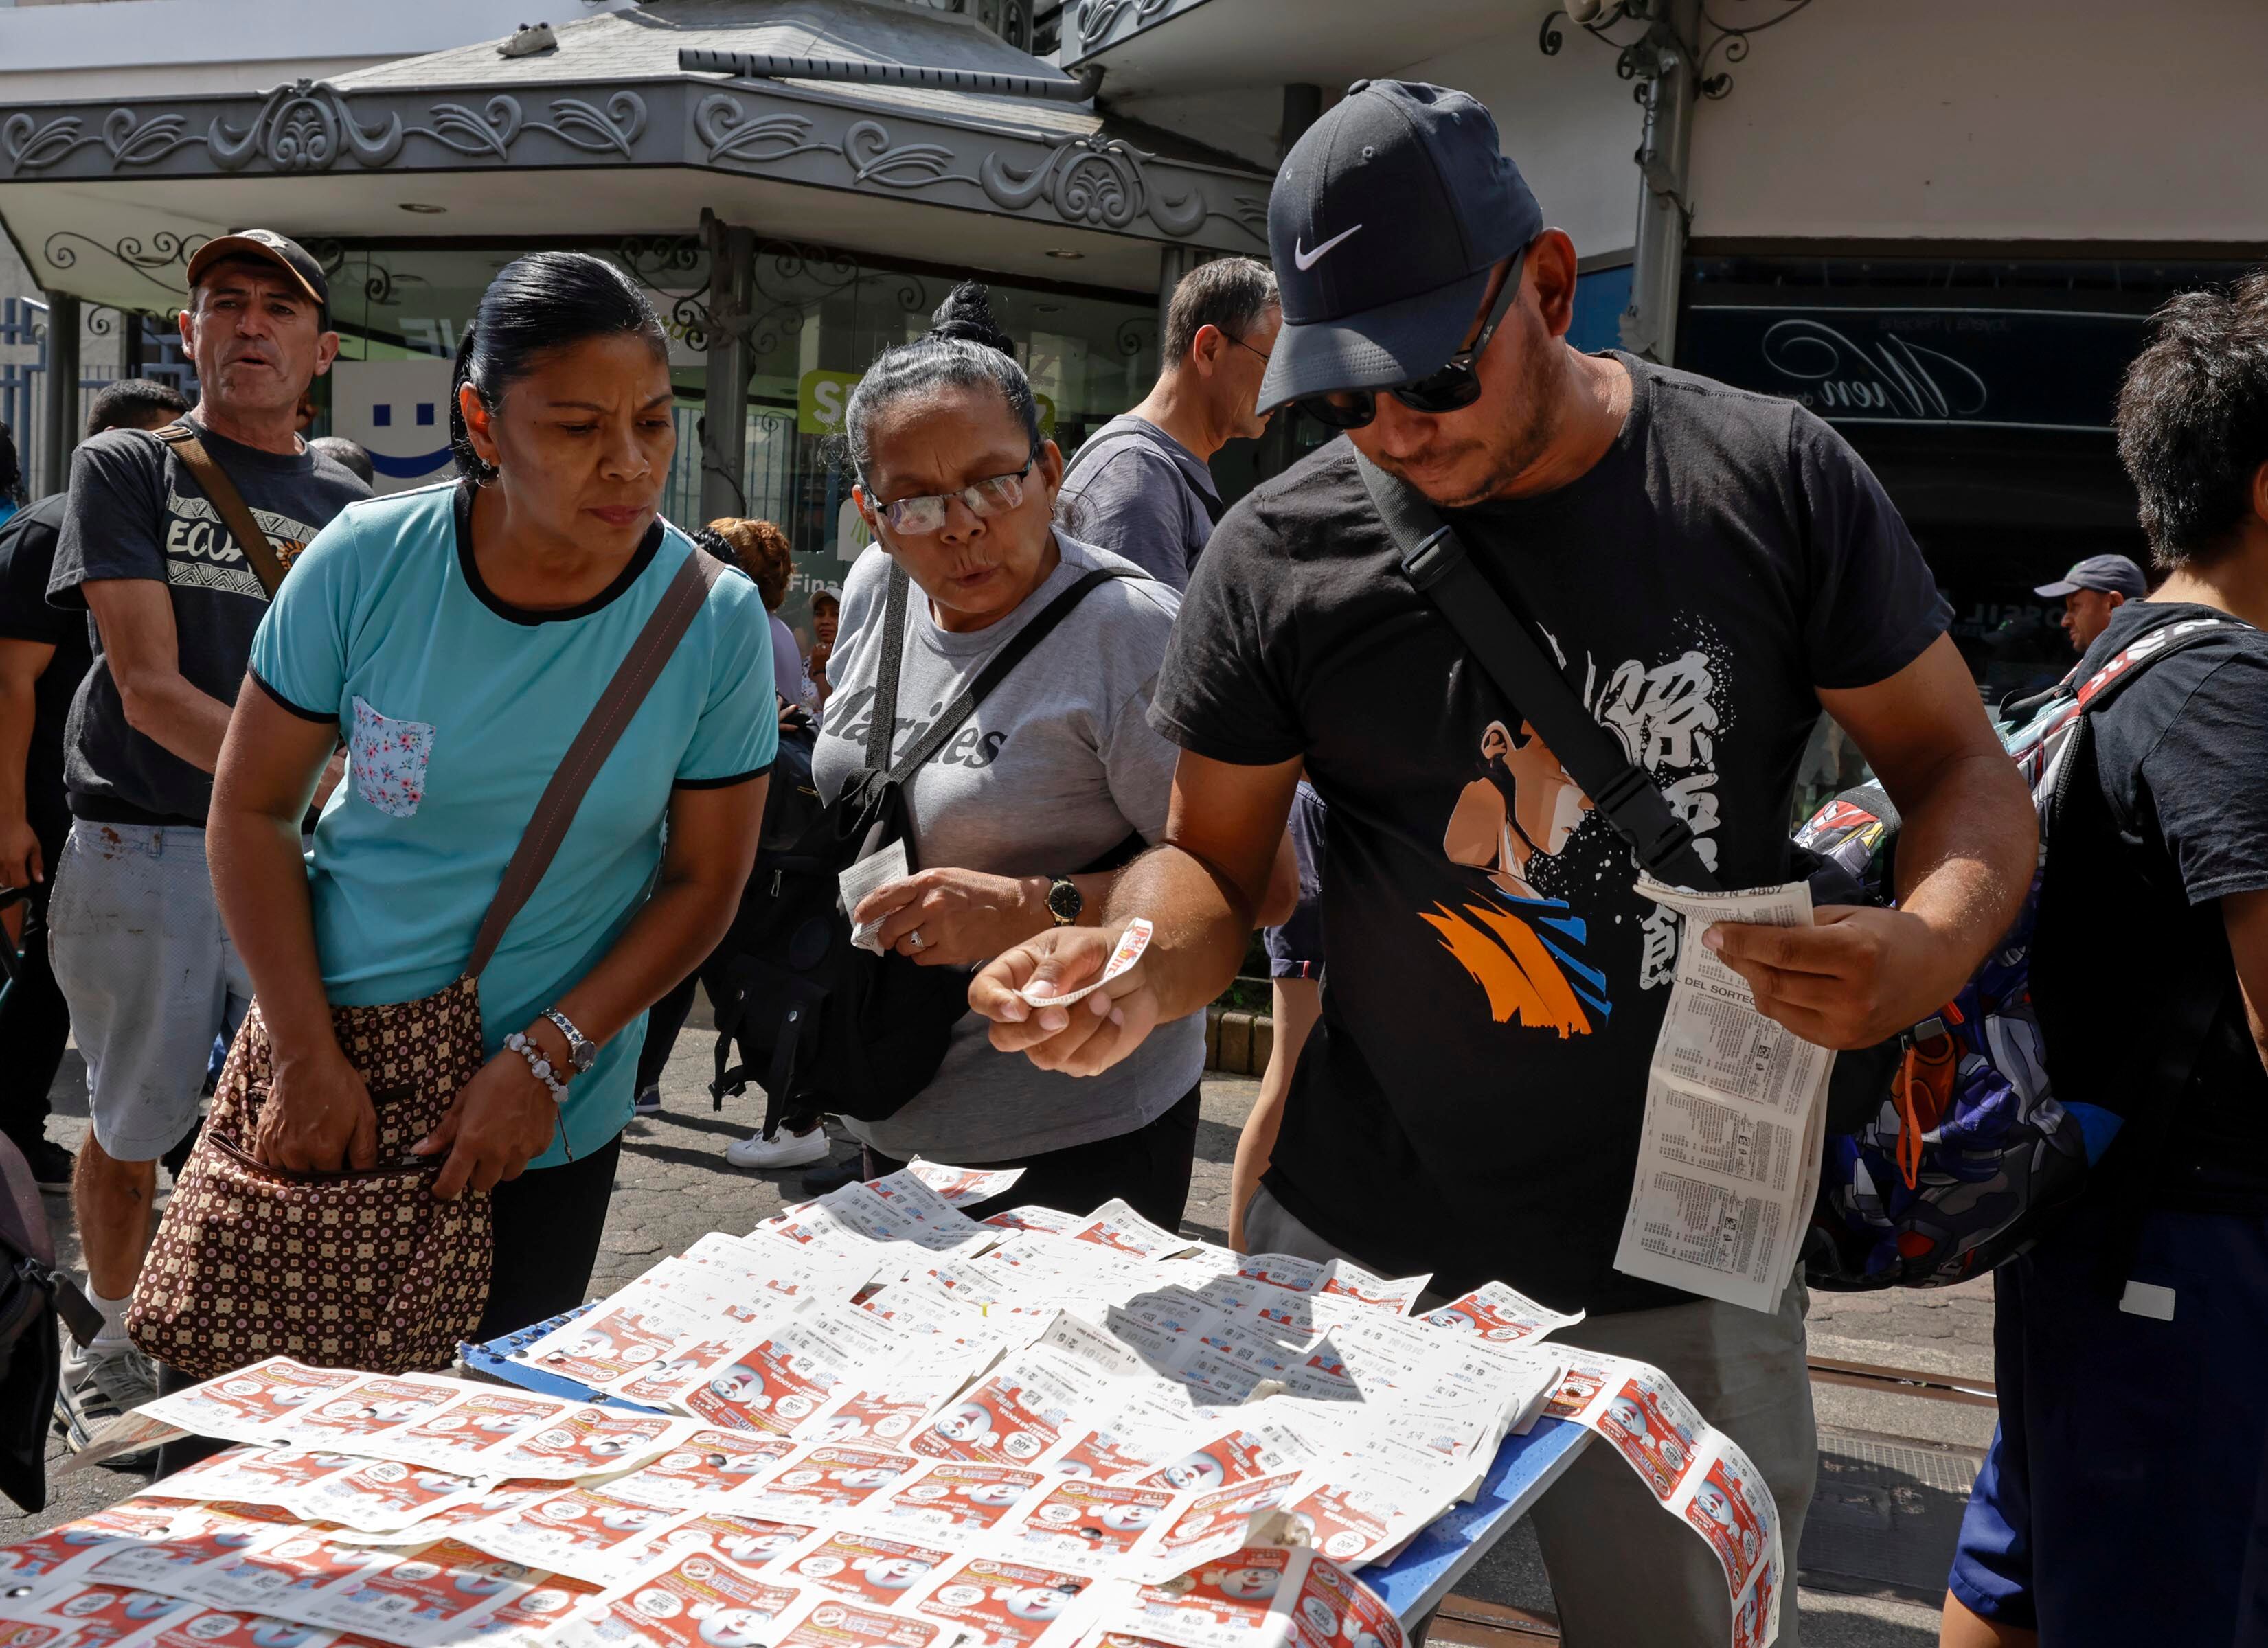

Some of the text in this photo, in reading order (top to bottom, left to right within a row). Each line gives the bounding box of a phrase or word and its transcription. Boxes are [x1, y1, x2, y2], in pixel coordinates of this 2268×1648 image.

[788, 574, 838, 592] Fina
[824, 680, 1008, 769] Maries
[1749, 885, 1783, 897] 4807
[1684, 976, 1707, 990] DEL
[1710, 985, 1756, 1005] SORTEO
[785, 1401, 803, 1412] 400
[1013, 1438, 1031, 1451] 400
[1664, 1447, 1679, 1462] 400
[1313, 1608, 1330, 1625] 400
